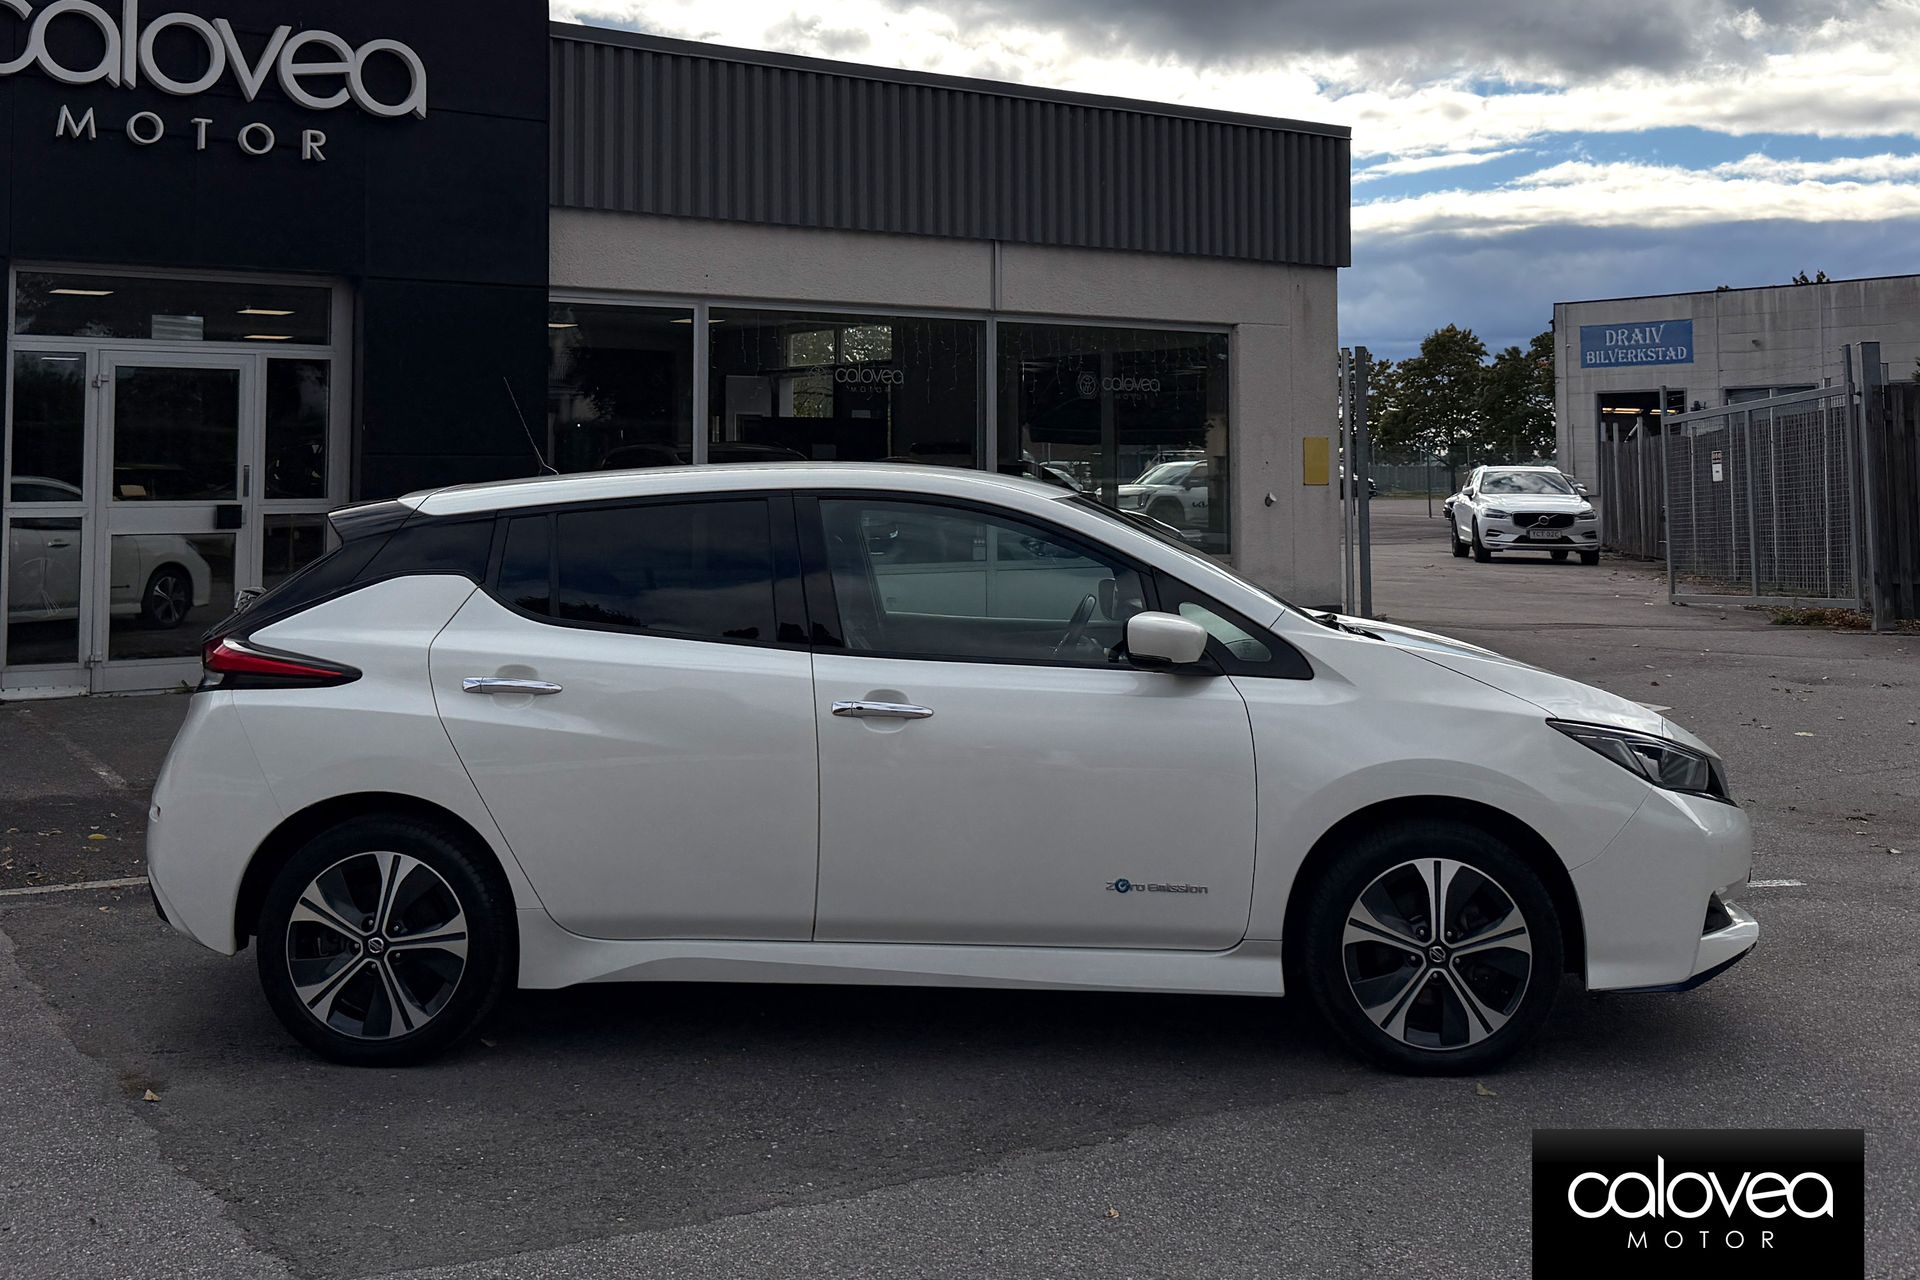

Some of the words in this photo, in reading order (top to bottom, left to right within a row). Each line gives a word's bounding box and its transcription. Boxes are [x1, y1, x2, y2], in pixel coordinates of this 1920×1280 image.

[56, 104, 327, 161] MOTOR
[1605, 323, 1666, 346] DRAIV
[1586, 346, 1687, 364] BILVERKSTAD
[834, 364, 904, 385] calovea
[1102, 372, 1161, 392] calovea
